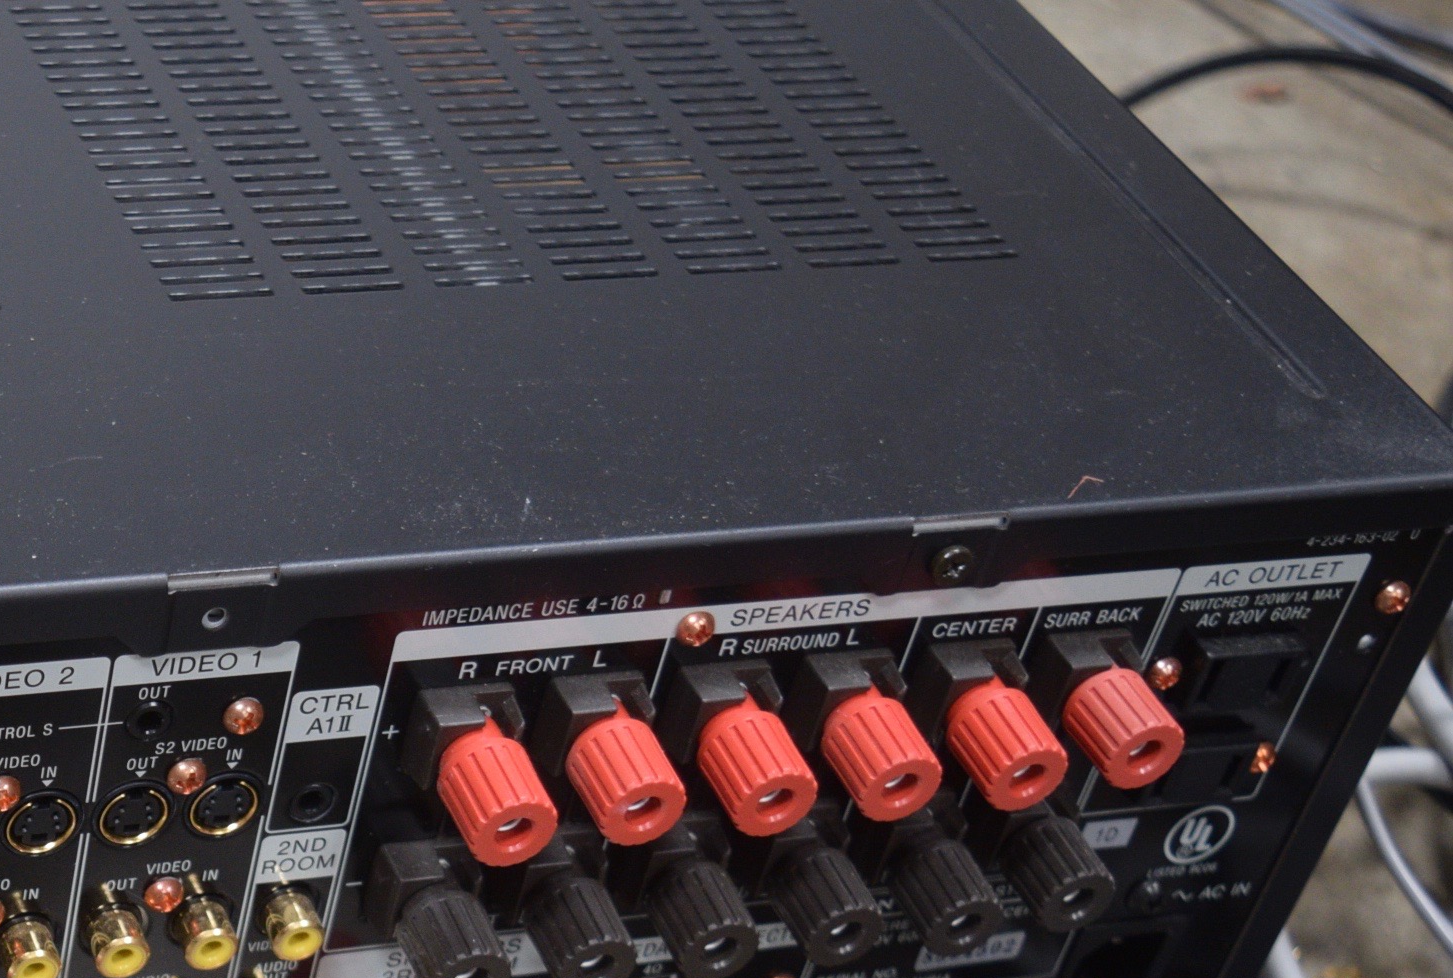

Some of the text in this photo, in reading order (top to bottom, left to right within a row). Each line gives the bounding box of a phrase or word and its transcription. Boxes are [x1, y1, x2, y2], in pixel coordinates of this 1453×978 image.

[1205, 561, 1344, 588] AC OUTLET
[1180, 594, 1250, 613] SWITCHED
[1312, 587, 1344, 602] MAX
[423, 602, 534, 627] IMPEDANCE
[541, 599, 579, 617] USE
[586, 596, 629, 614] 4-16
[730, 598, 872, 628] SPEAKERS
[1044, 605, 1143, 629] SURR BACK
[1196, 605, 1312, 628] AC 120V 60Hz
[932, 616, 1018, 640] CENTER
[718, 628, 860, 657] R SURROUND L
[151, 651, 262, 678] VIDEO 1
[458, 650, 608, 680] R FRONT L
[59, 667, 76, 685] 2
[138, 686, 171, 700] OUT
[299, 692, 370, 715] CTRL
[42, 723, 54, 737] S
[155, 737, 228, 756] S2 VIDEO
[226, 748, 243, 762] IN
[40, 766, 57, 779] IN
[126, 755, 159, 771] OUT
[277, 838, 328, 856] 2ND
[146, 860, 192, 875] VIDEO
[261, 853, 336, 876] ROOM
[106, 877, 137, 892] OUT
[202, 869, 219, 882] IN
[23, 887, 40, 900] IN
